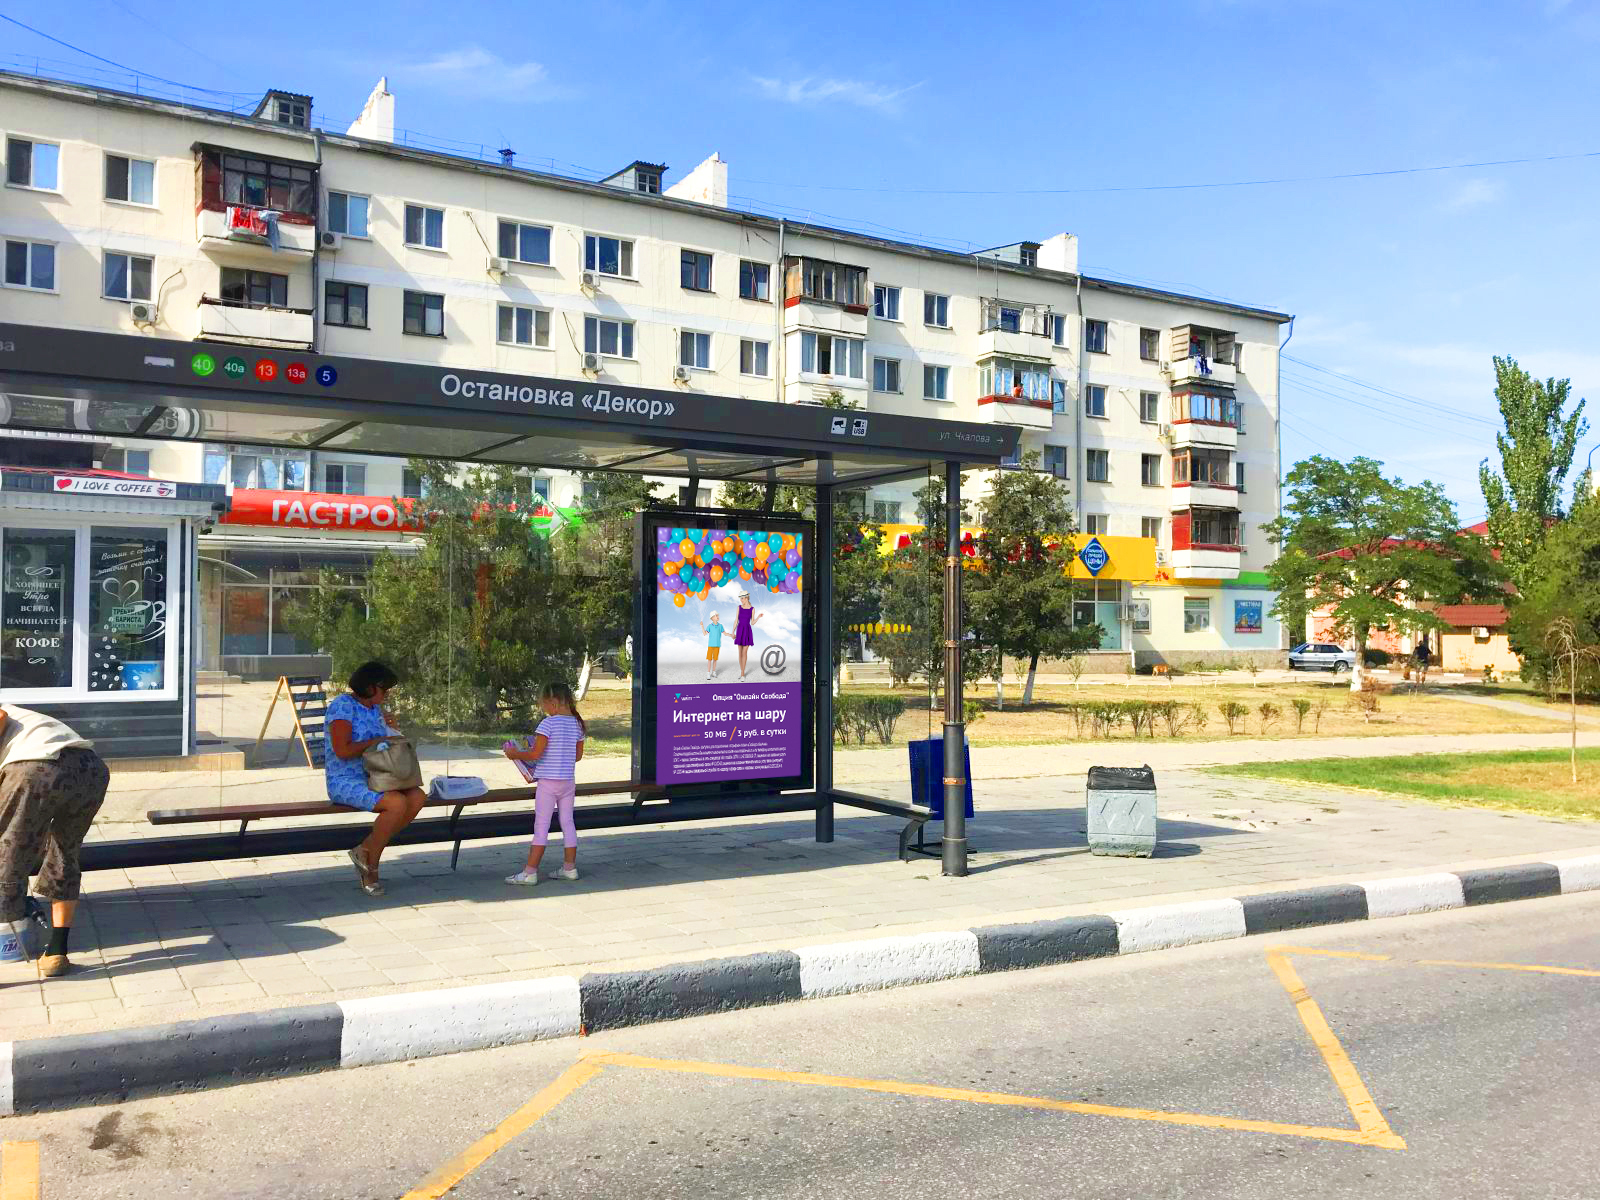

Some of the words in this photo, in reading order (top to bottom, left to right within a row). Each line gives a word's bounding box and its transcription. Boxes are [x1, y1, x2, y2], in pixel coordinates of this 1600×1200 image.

[192, 358, 211, 371] 40
[224, 362, 245, 373] 40а
[258, 365, 273, 376] 13
[287, 367, 306, 378] 13а
[321, 370, 330, 382] 5
[440, 373, 574, 406] Остановка
[581, 389, 675, 419] «Декор»
[853, 427, 865, 435] USB
[955, 431, 991, 443] Чкалова
[83, 481, 110, 491] LOVE
[114, 483, 153, 494] COFFEE
[22, 590, 50, 601] Утро
[15, 637, 60, 648] КОФЕ
[712, 694, 733, 702] Опция
[673, 709, 734, 725] Интернет
[736, 711, 751, 721] на
[754, 709, 787, 723] шару
[704, 731, 714, 739] 50
[743, 730, 759, 738] руб.
[766, 729, 787, 737] сутки
